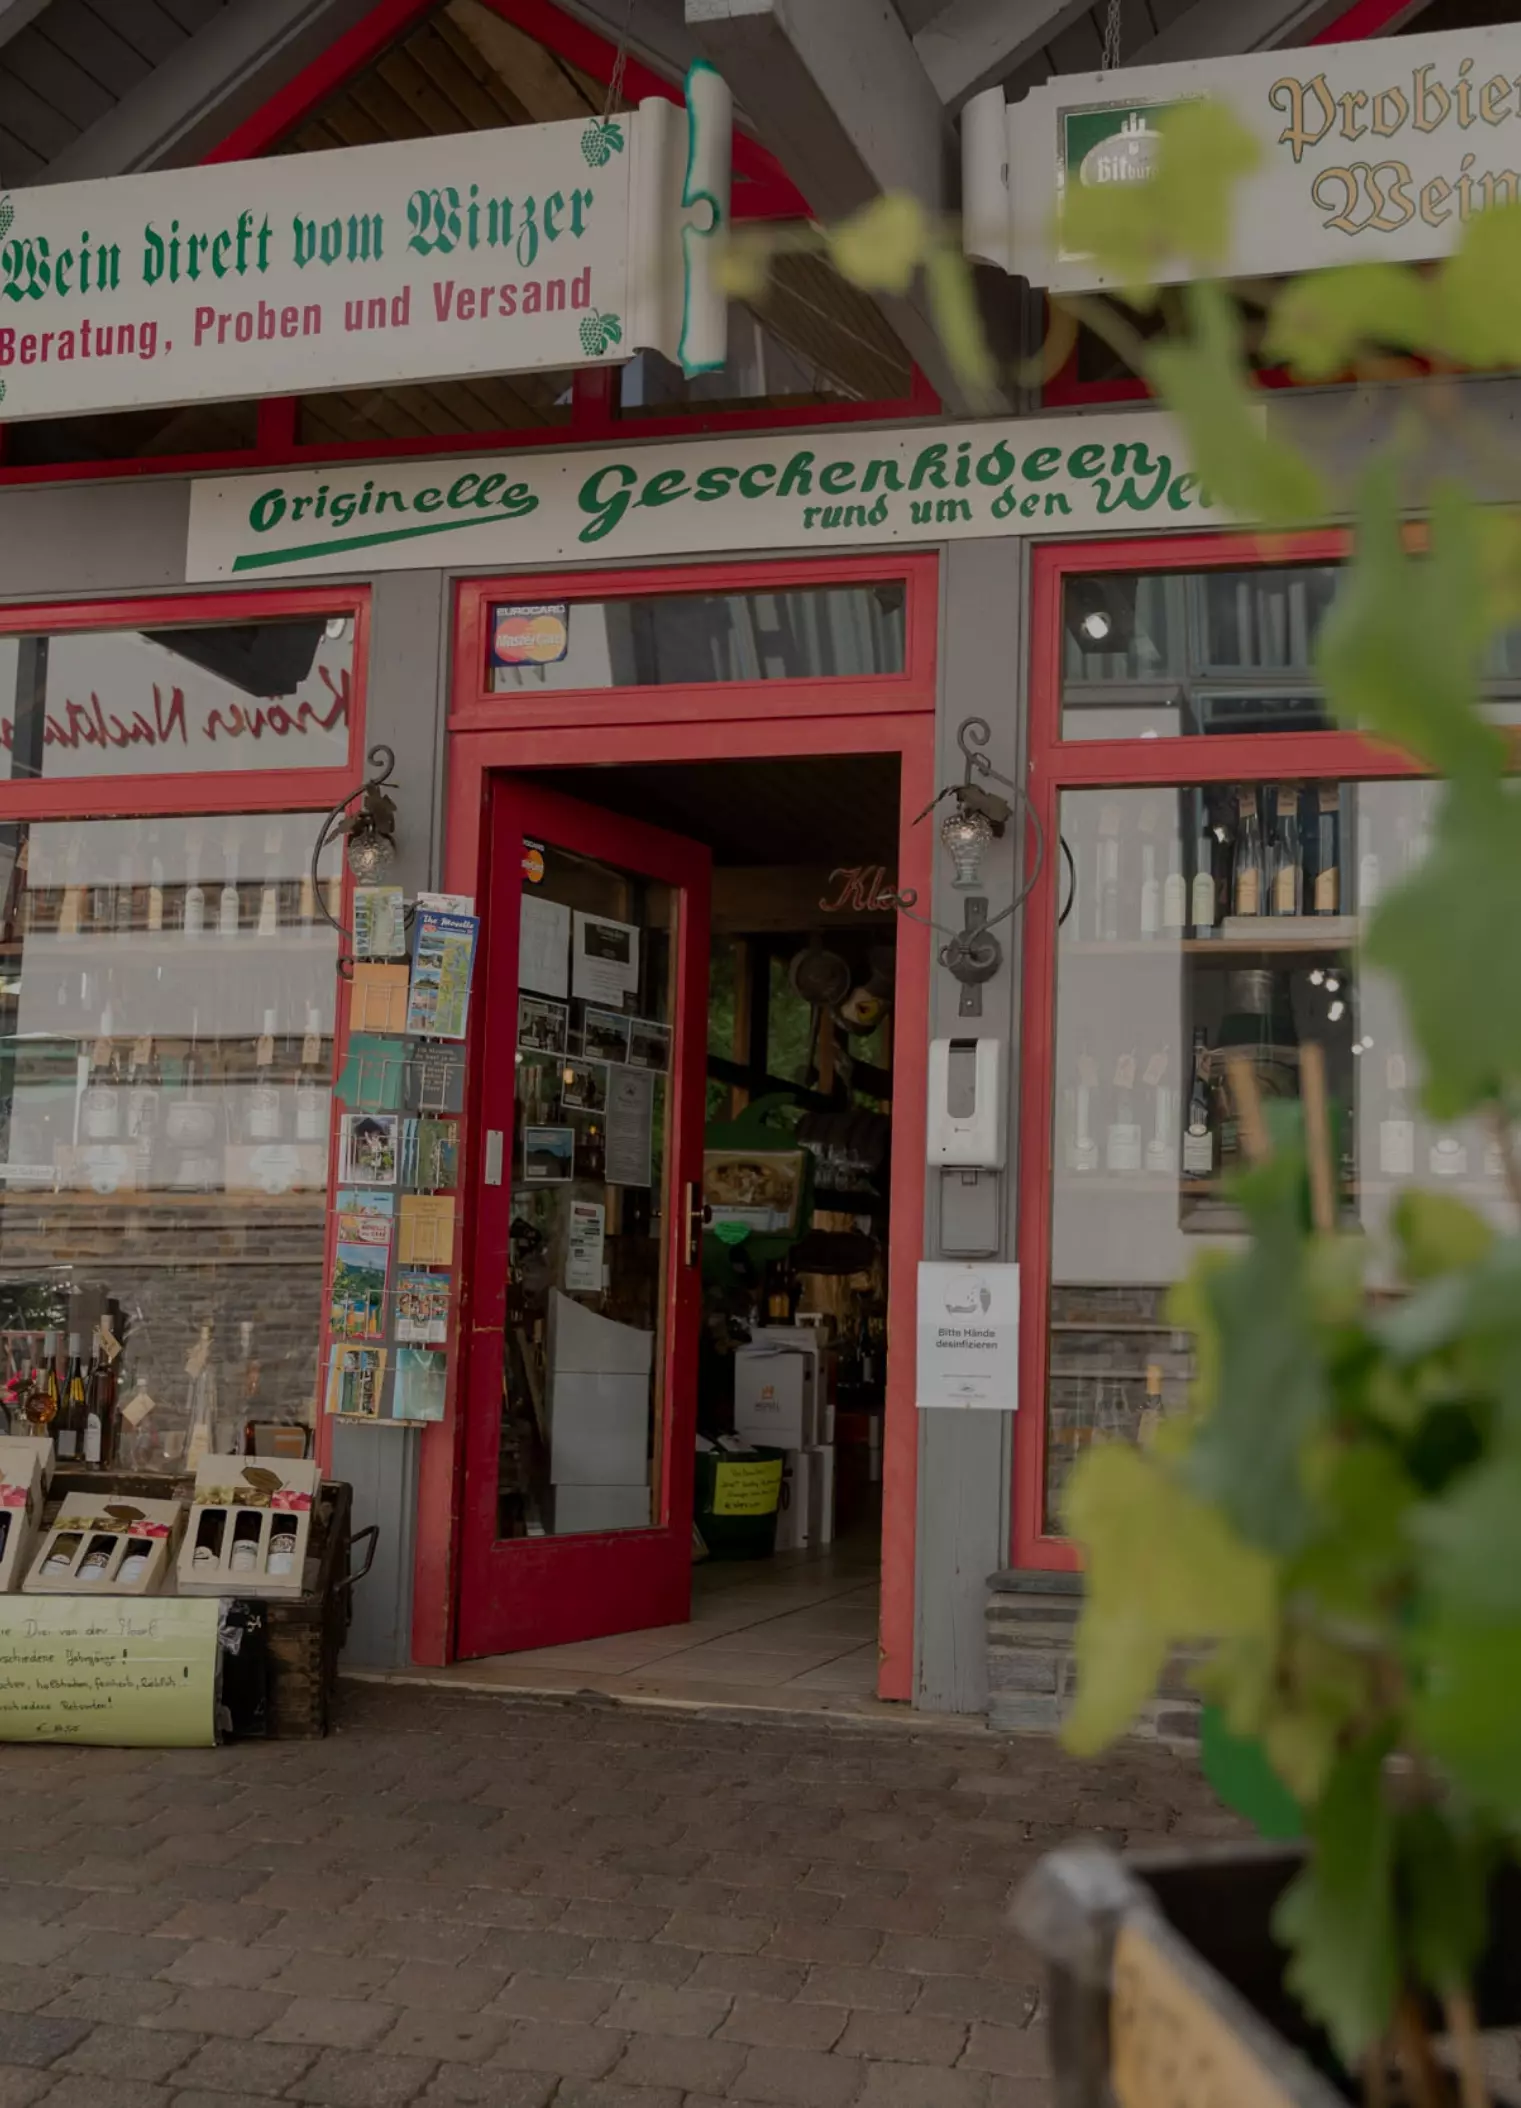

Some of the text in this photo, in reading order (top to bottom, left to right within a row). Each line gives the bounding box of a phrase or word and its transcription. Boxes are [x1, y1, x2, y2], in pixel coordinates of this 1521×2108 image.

[1268, 57, 1521, 164] Probie
[0, 182, 594, 302] Wein direkt vom Winzer
[0, 267, 592, 367] Beratung, Proben und Versand
[249, 441, 1157, 543] Originelle Geschenkideen
[803, 493, 888, 530] rund
[911, 498, 973, 526] um
[992, 487, 1072, 520] den
[496, 605, 566, 616] EUROCARD
[936, 1339, 998, 1350] desinfizieren
[938, 1328, 996, 1339] Bitte Hände
